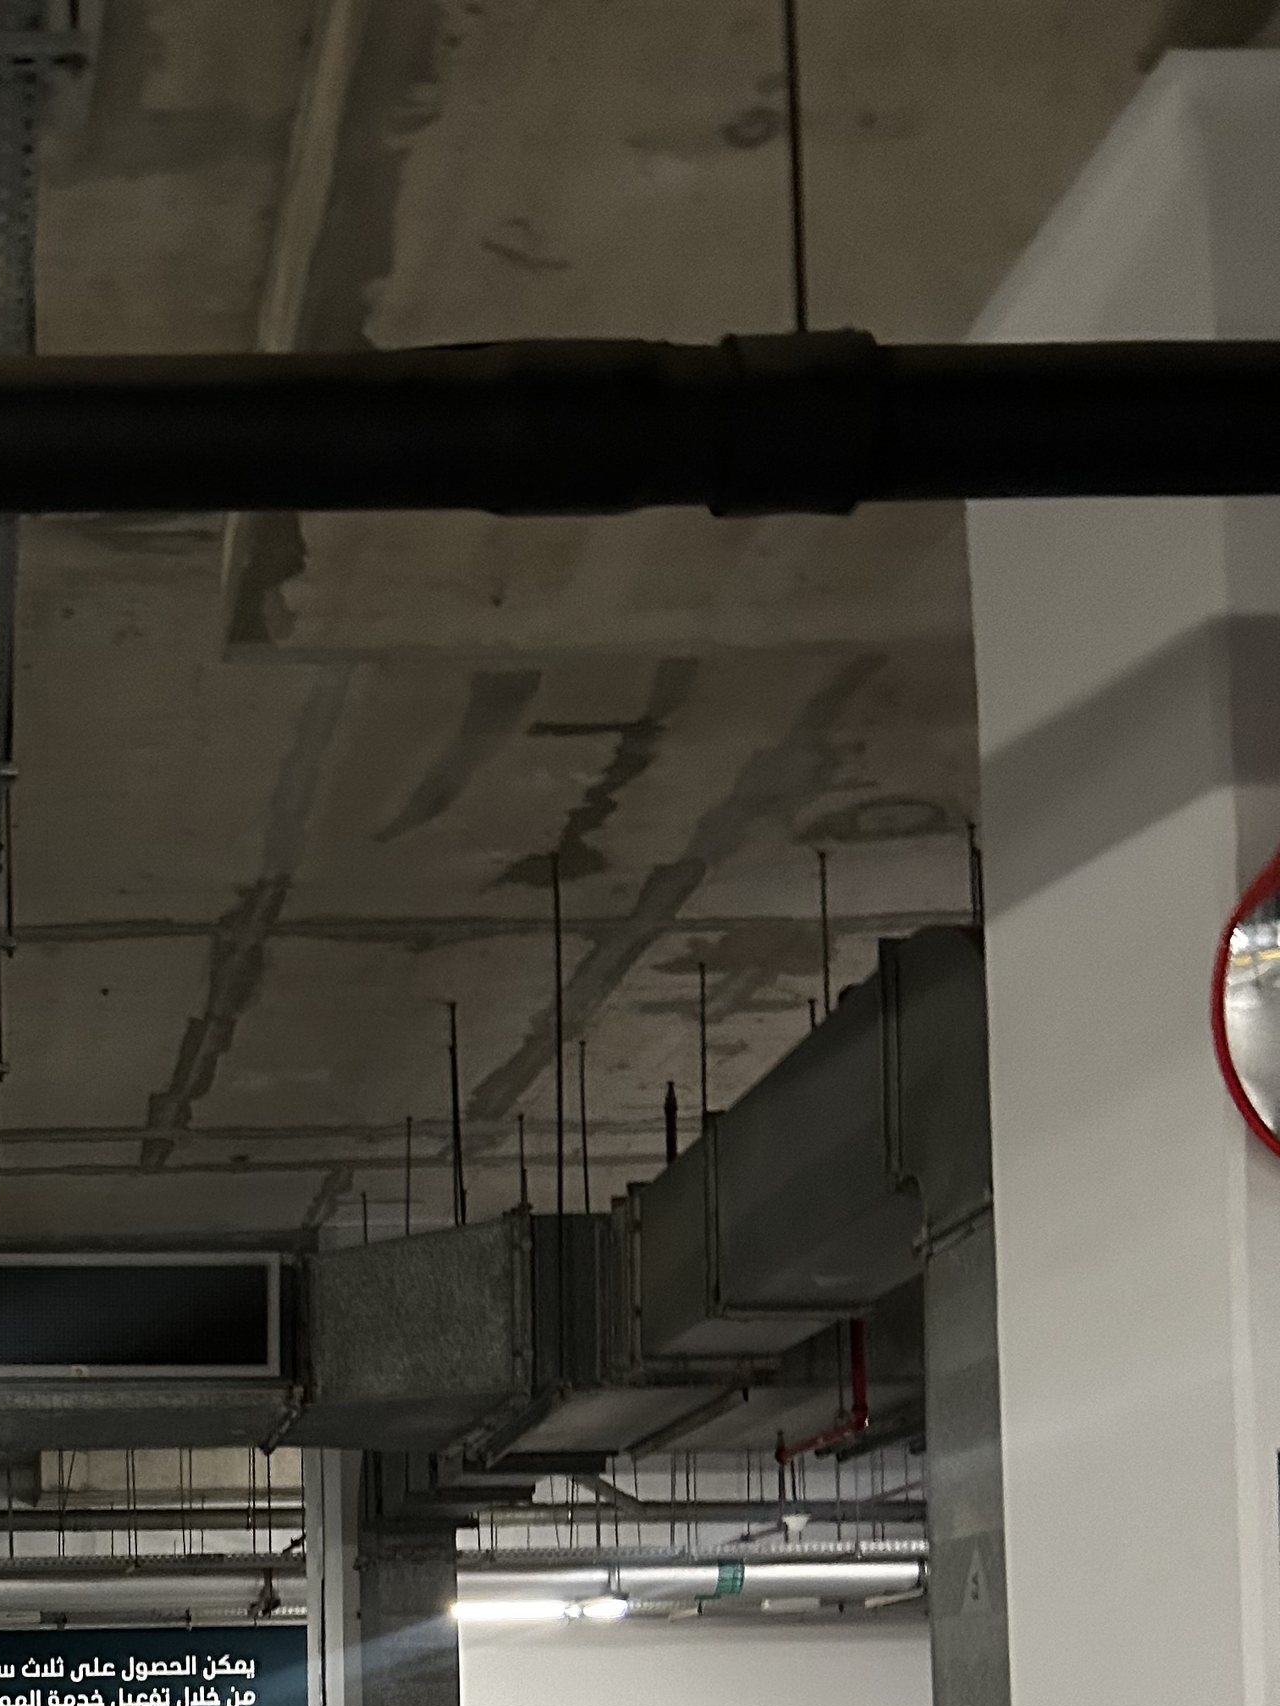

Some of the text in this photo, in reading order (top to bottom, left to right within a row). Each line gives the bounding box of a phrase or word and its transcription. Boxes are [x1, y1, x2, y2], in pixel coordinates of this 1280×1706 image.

[21, 1656, 65, 1677] ثلاث
[69, 1657, 116, 1682] على
[121, 1656, 197, 1681] الحصول
[202, 1655, 256, 1680] يمكن
